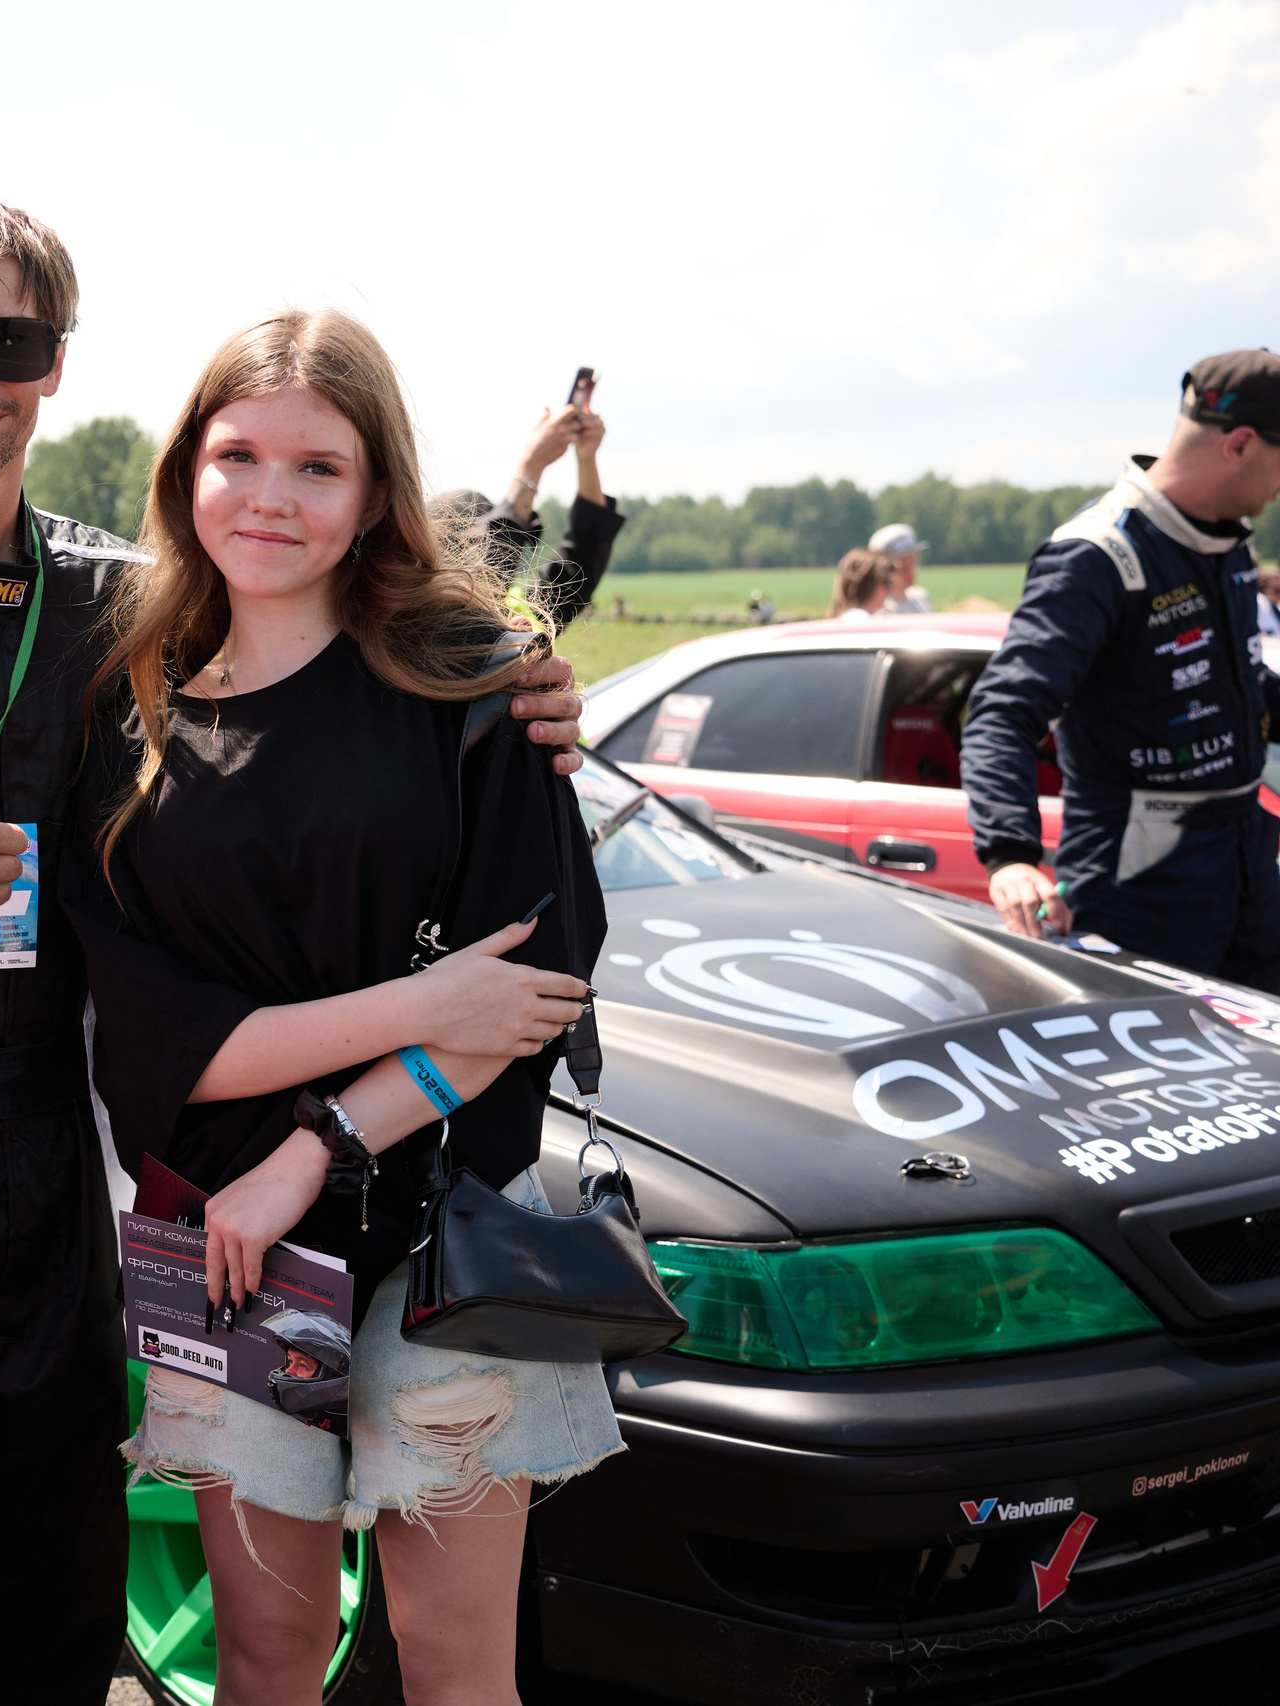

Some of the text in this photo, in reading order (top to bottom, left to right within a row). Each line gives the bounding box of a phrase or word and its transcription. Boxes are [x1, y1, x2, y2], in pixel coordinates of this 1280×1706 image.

[853, 1009, 1280, 1140] OMEGA
[1039, 1072, 1280, 1143] MOTORS
[1058, 1103, 1280, 1185] #PotatoFi
[127, 1221, 162, 1236] ПИЛОТ
[128, 1233, 182, 1254] GARAGE22
[280, 1272, 307, 1289] DRIFT
[309, 1284, 335, 1301] TEAM
[160, 1342, 223, 1372] GOOD_DEED_AUTO
[1147, 1451, 1250, 1490] sergei_poklonov
[997, 1496, 1074, 1521] Valvoline
